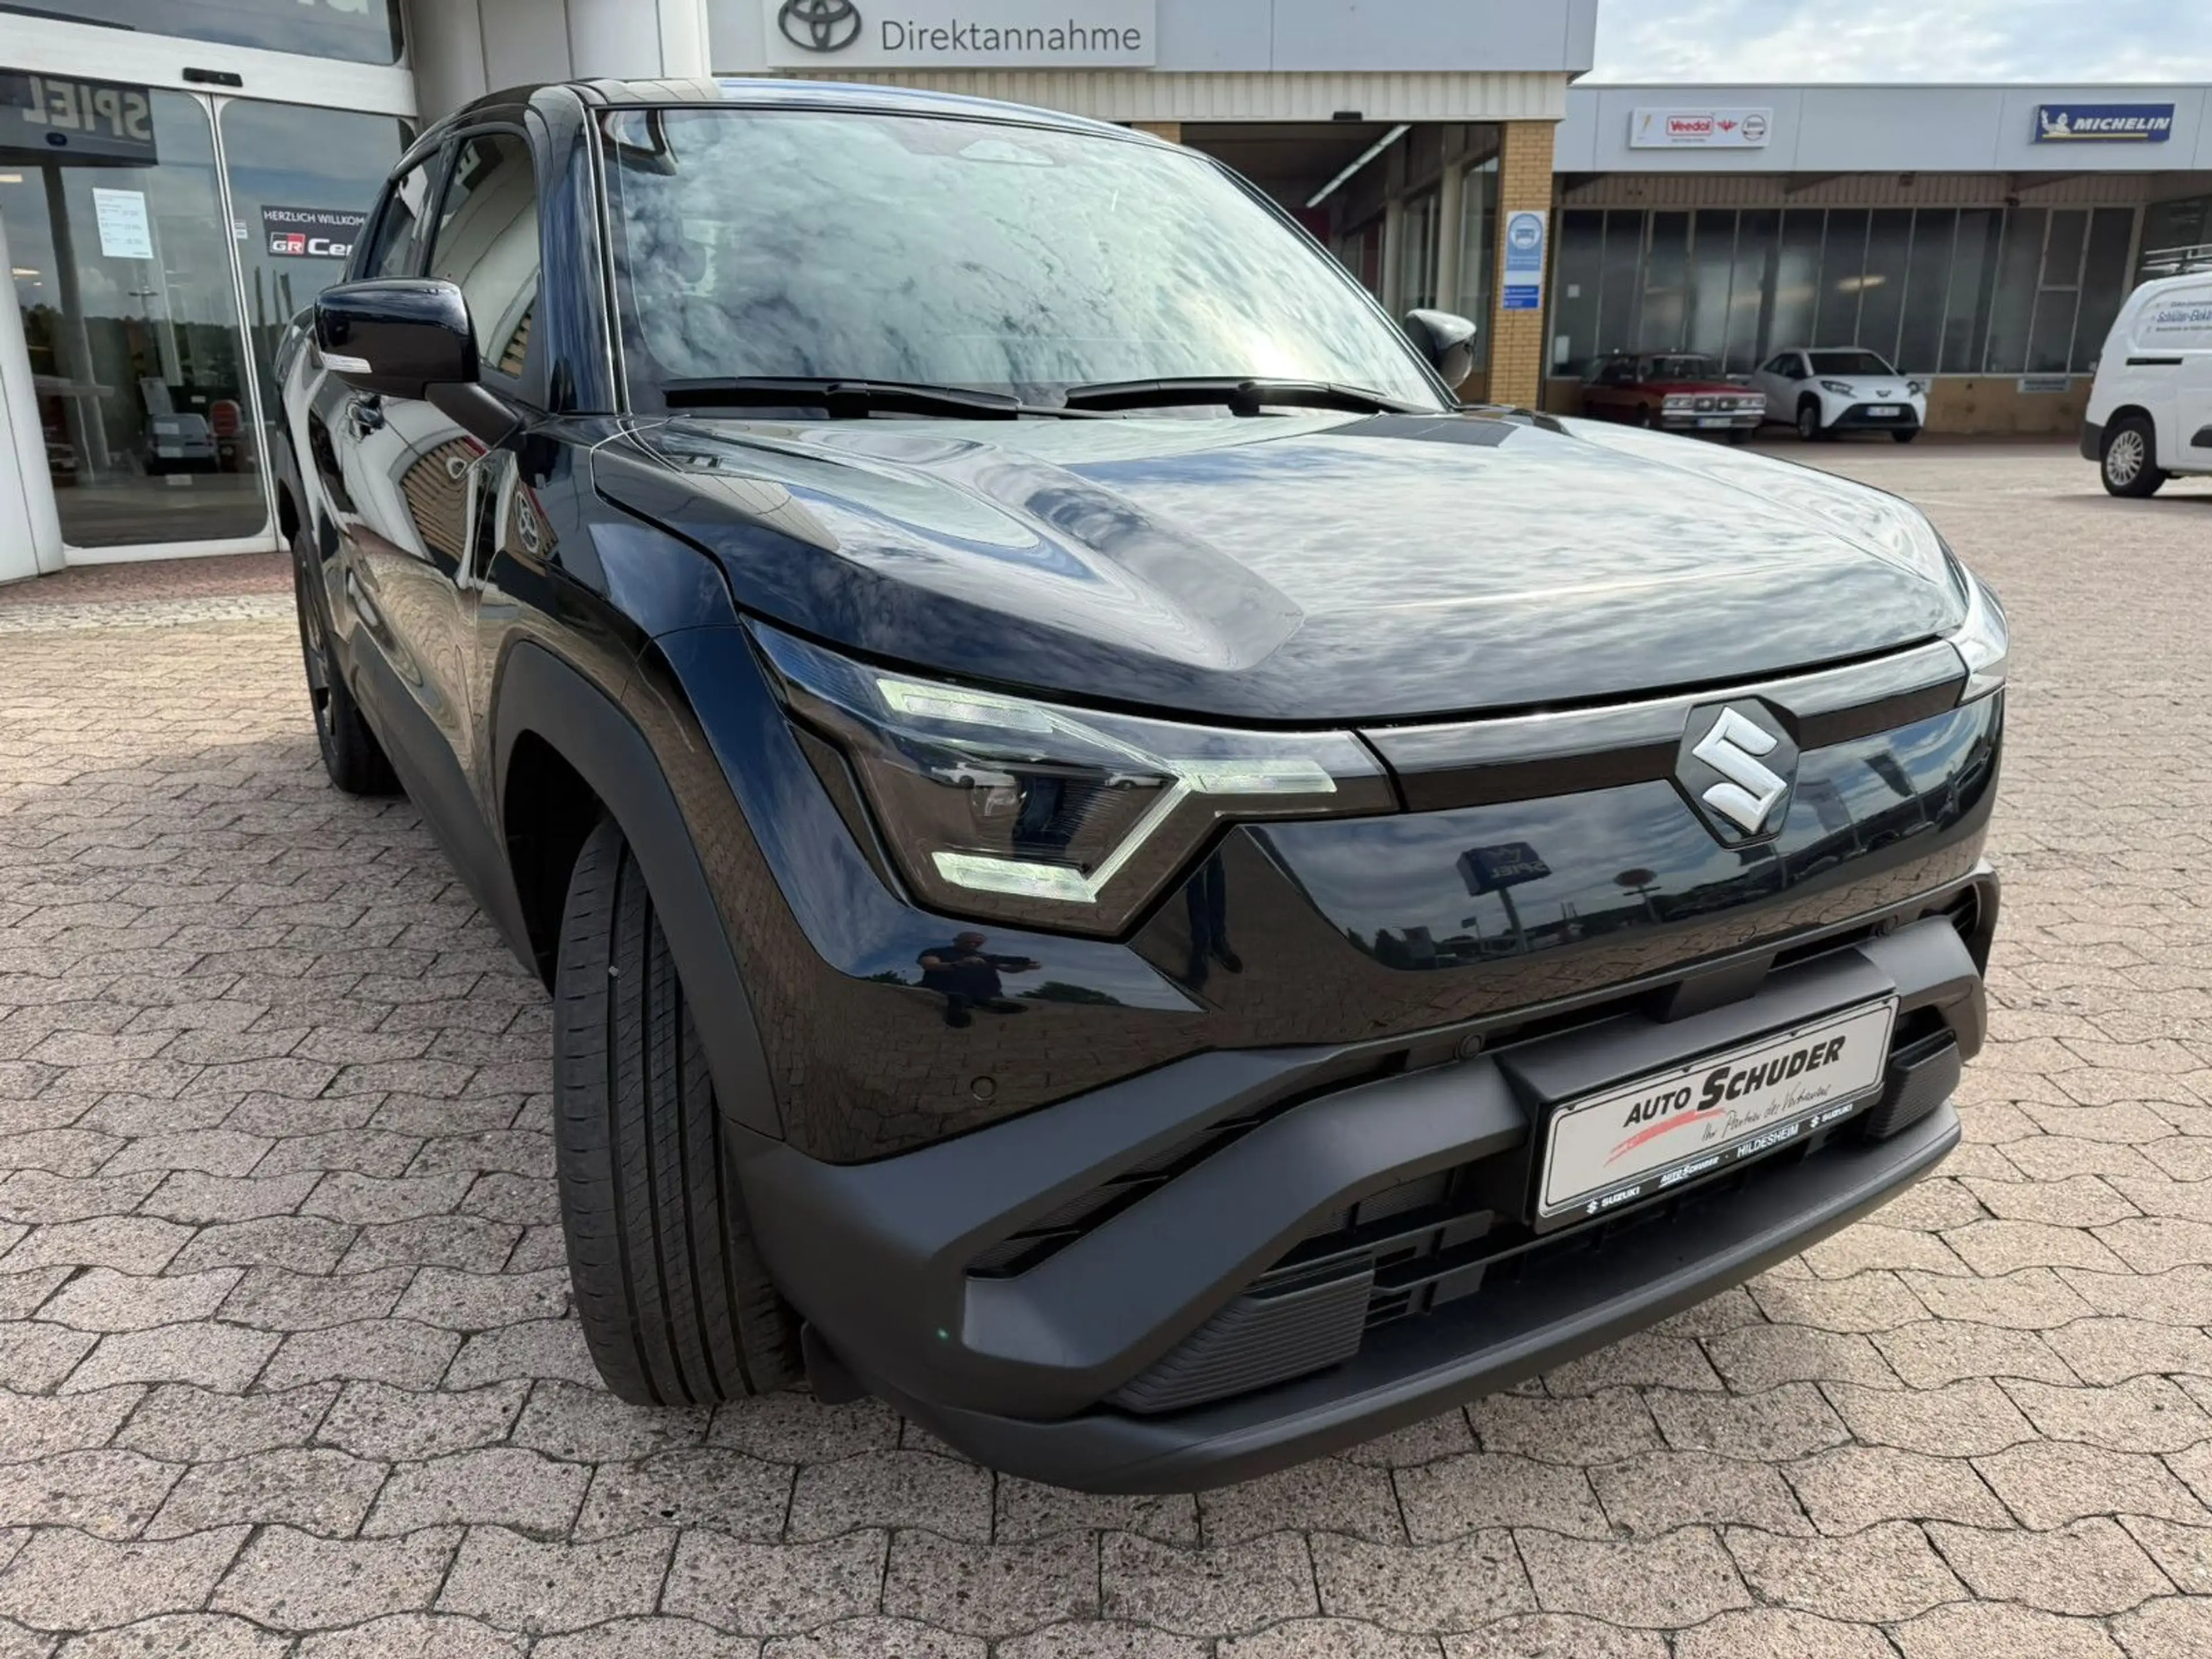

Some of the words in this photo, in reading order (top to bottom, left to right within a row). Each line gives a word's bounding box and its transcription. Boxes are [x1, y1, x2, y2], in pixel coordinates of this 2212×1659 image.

[881, 19, 1141, 51] Direktannahme
[2073, 118, 2171, 130] MICHELIN
[263, 210, 316, 223] HERZLICH
[272, 240, 302, 252] GR
[1623, 1086, 1692, 1128] AUTO
[1696, 1036, 1846, 1111] SCHUDER
[1601, 1185, 1641, 1207] SUZUKI
[1737, 1122, 1800, 1158] HILDESHEIM
[1821, 1103, 1854, 1123] SUZUKI
